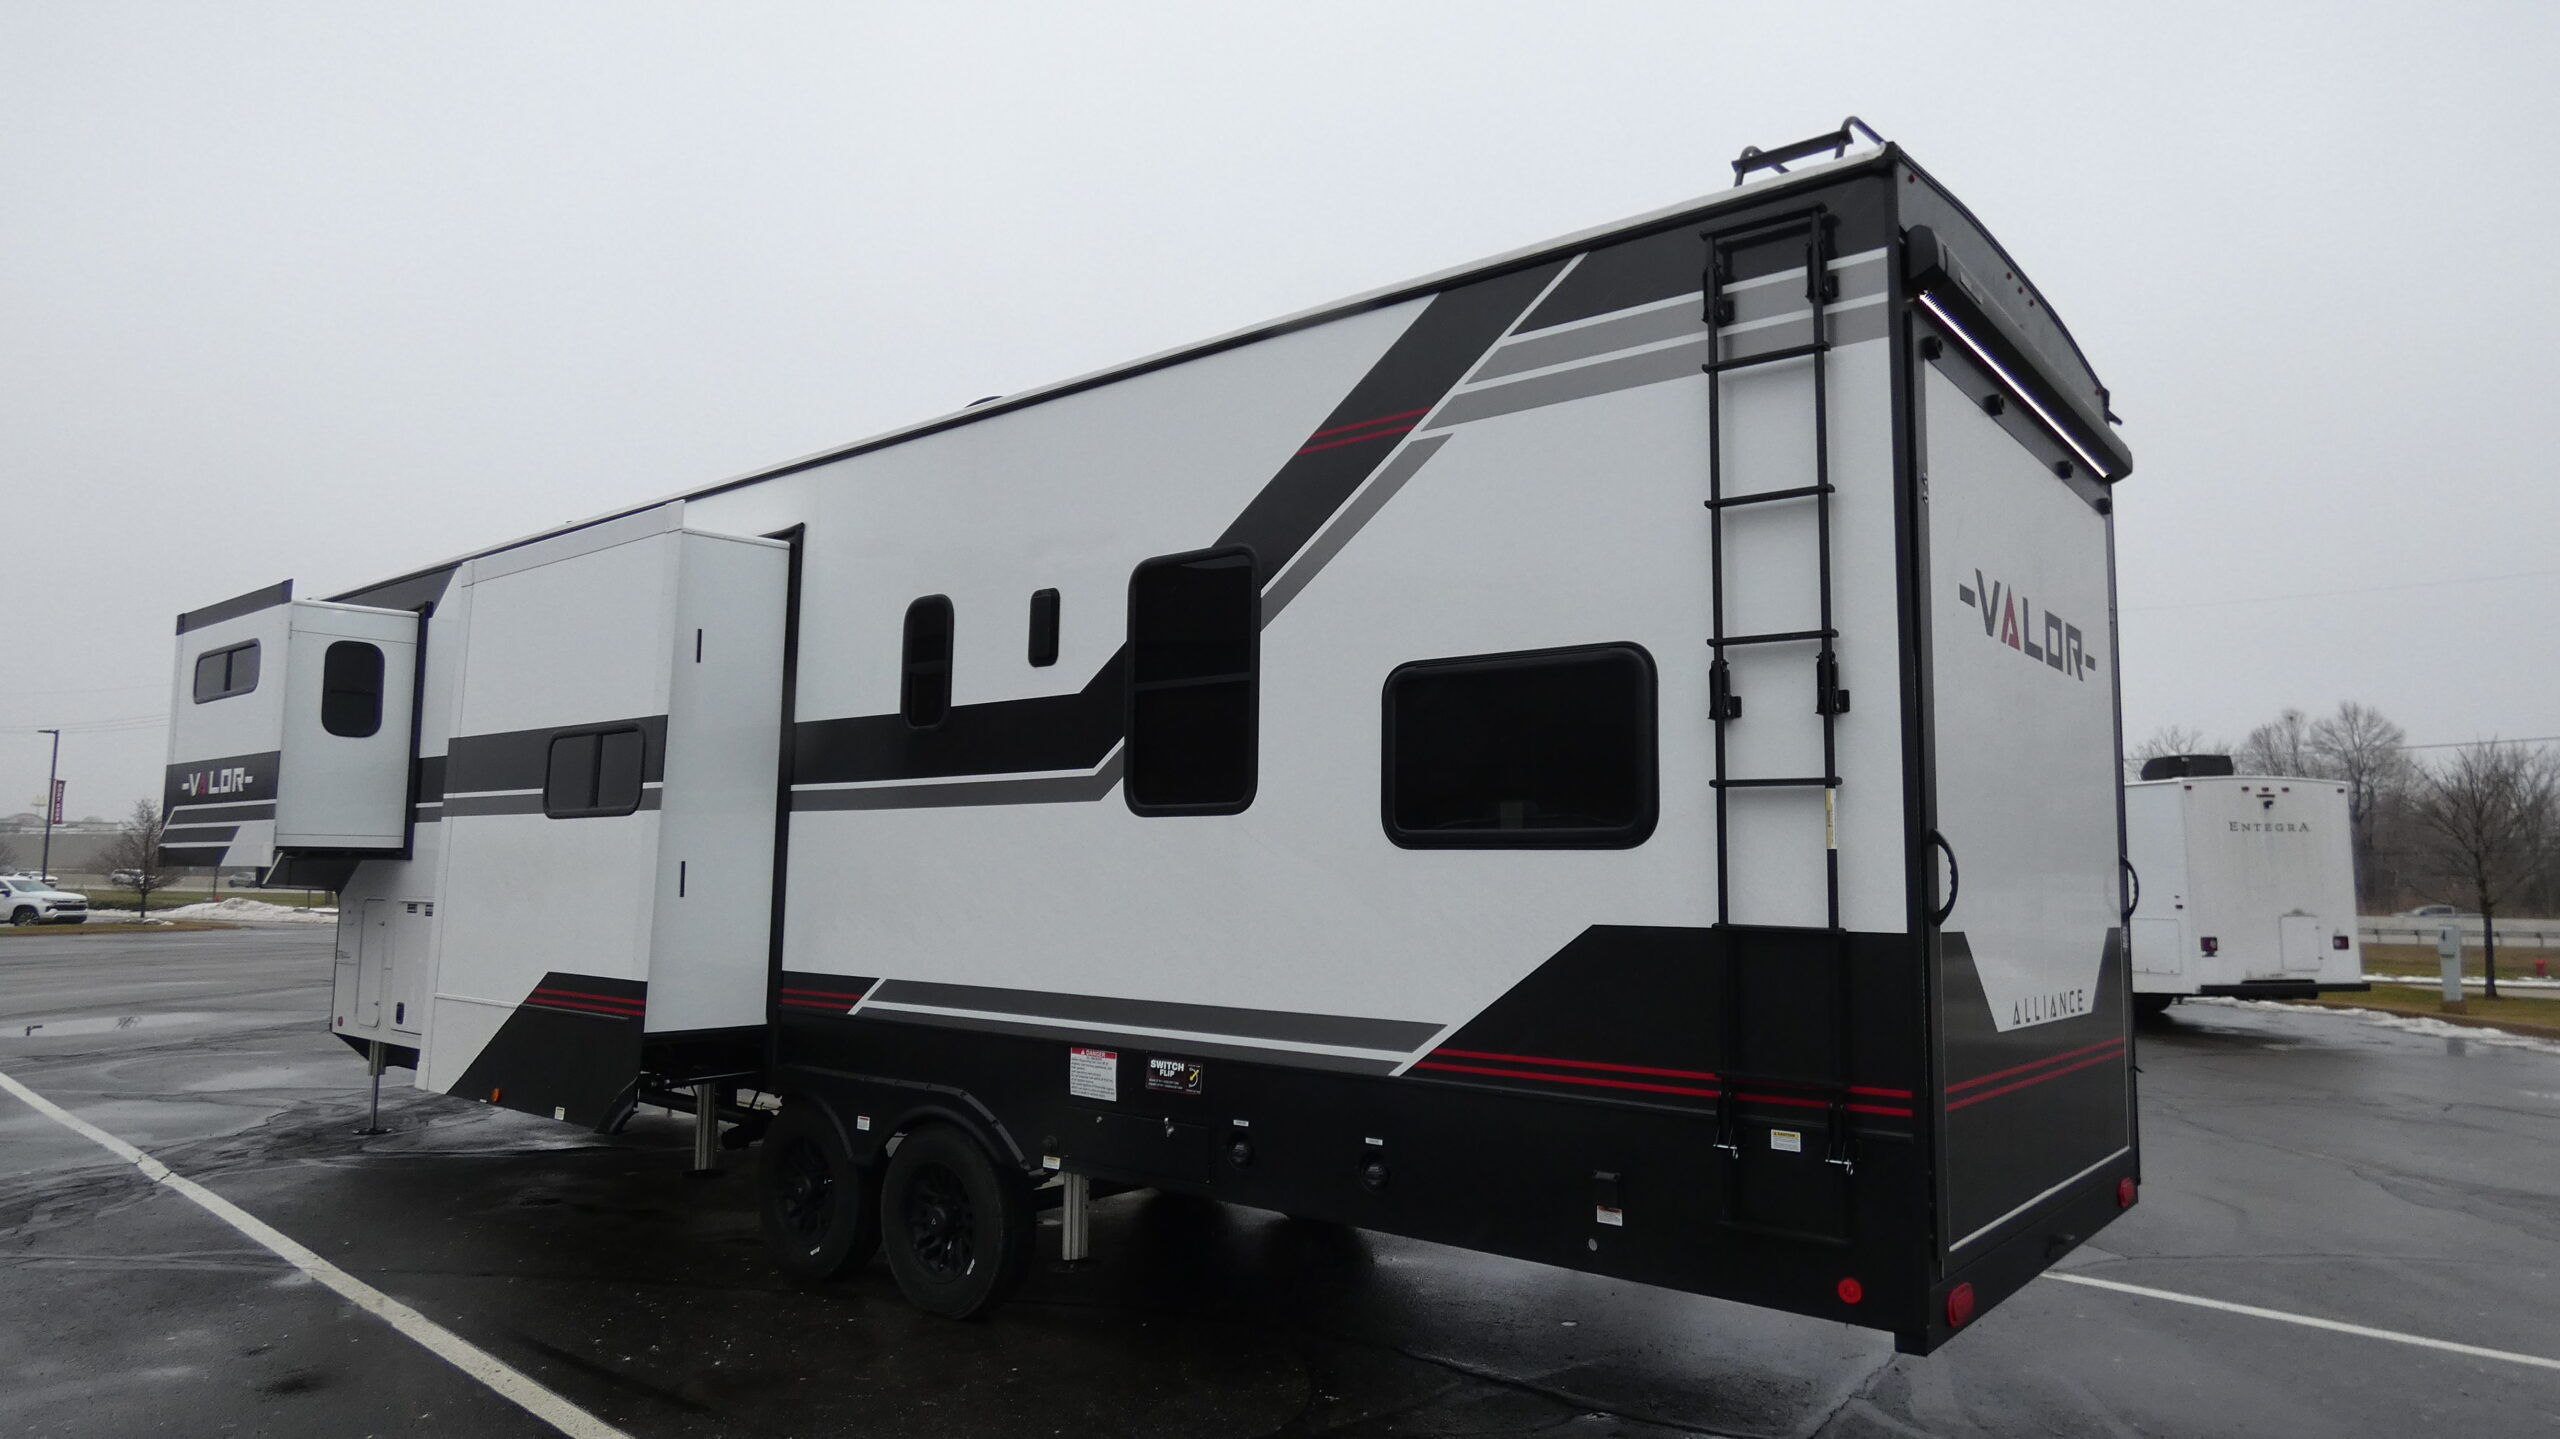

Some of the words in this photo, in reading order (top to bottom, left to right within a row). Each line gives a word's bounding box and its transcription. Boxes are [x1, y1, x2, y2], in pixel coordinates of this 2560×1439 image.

[2013, 989, 2083, 1025] ALLIANCE
[1150, 1059, 1185, 1072] SWITCH
[1159, 1069, 1175, 1077] FLIP
